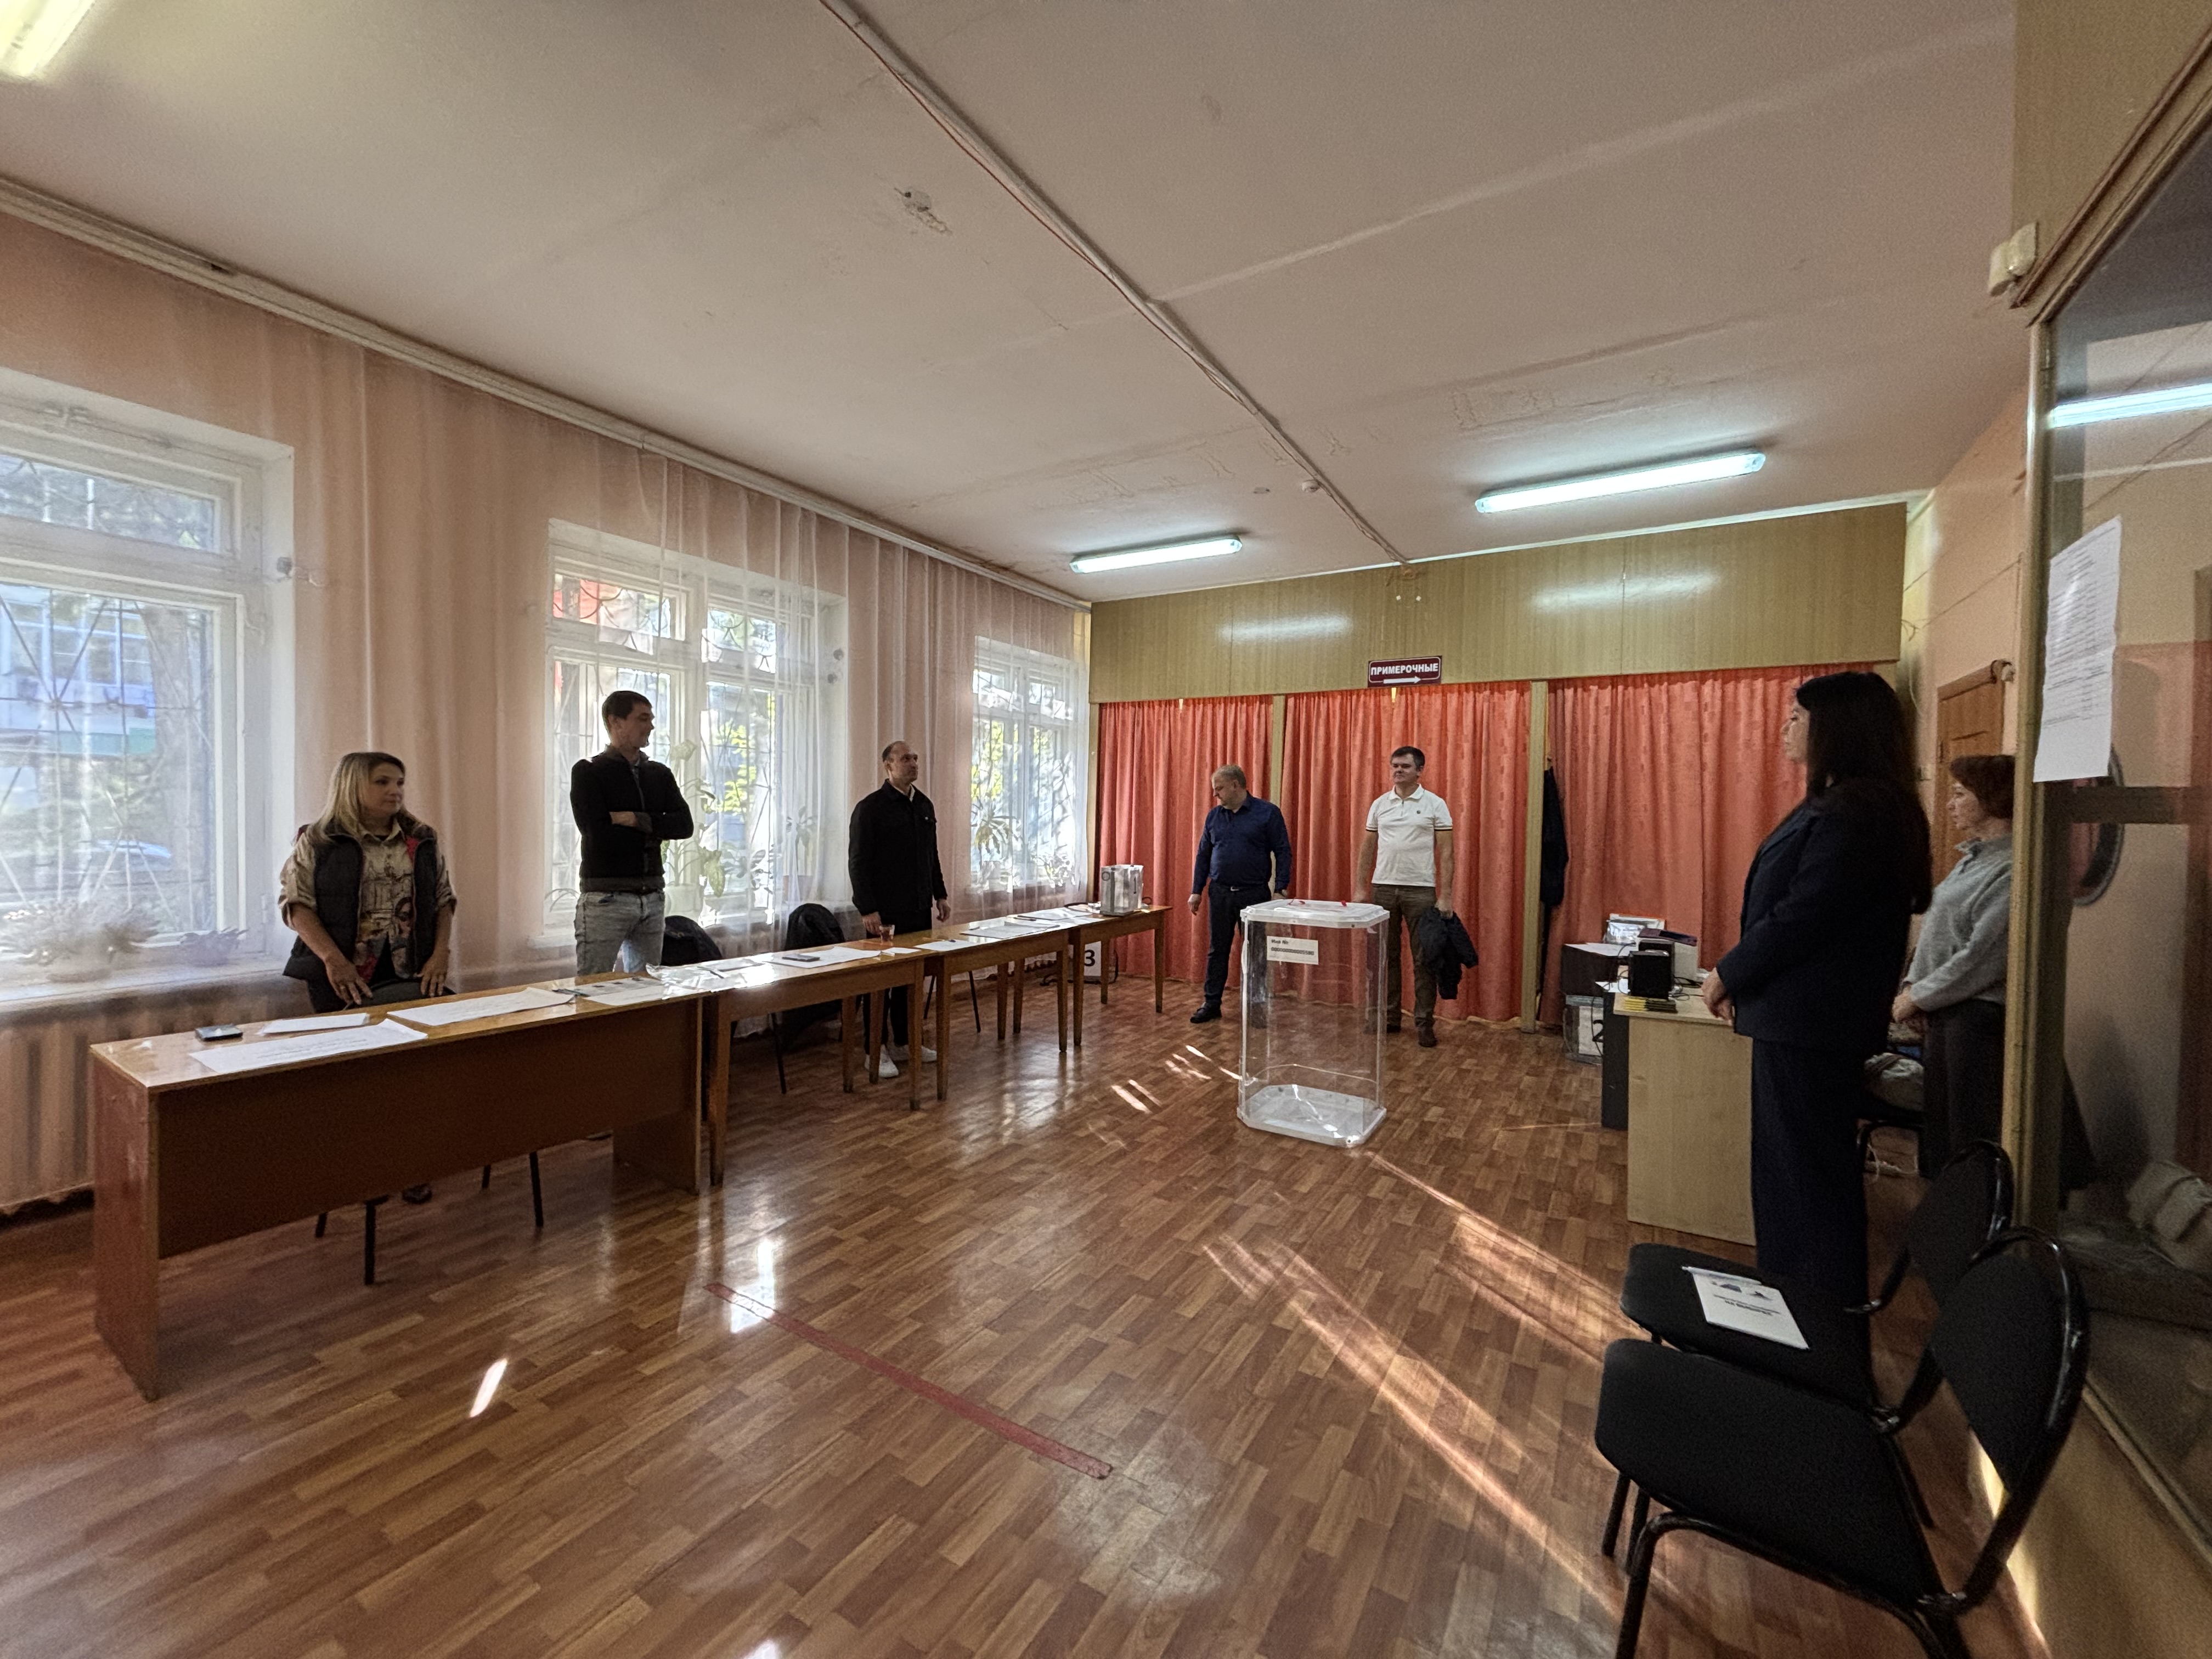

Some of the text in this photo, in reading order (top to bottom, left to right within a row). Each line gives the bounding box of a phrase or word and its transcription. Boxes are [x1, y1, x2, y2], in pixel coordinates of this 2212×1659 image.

[1370, 663, 1438, 675] ПРИМЕРОЧНЫЕ
[1084, 950, 1096, 966] 3
[1593, 1019, 1604, 1043] 2
